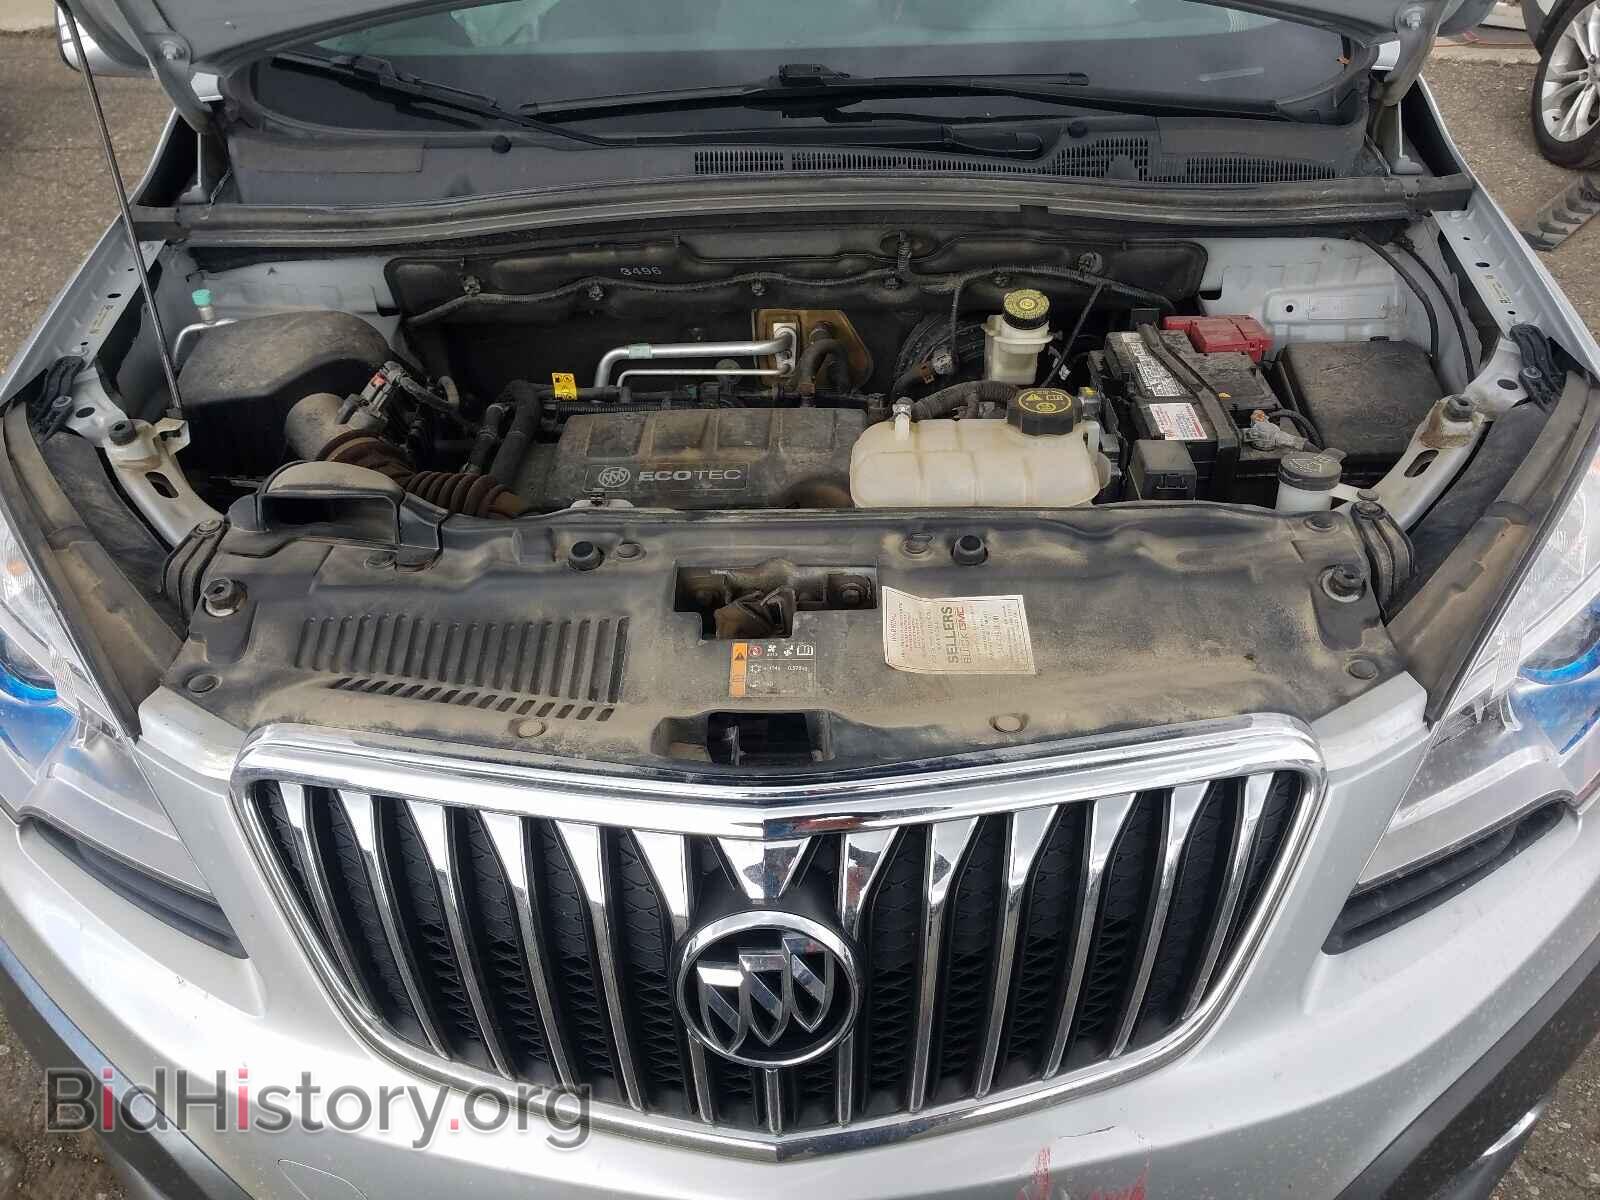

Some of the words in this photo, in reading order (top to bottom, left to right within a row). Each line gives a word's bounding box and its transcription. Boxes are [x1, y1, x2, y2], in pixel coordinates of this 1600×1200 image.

[620, 266, 662, 276] 3496
[639, 469, 742, 481] ECOTEC
[959, 607, 968, 631] GMC
[941, 606, 960, 664] SELLERS
